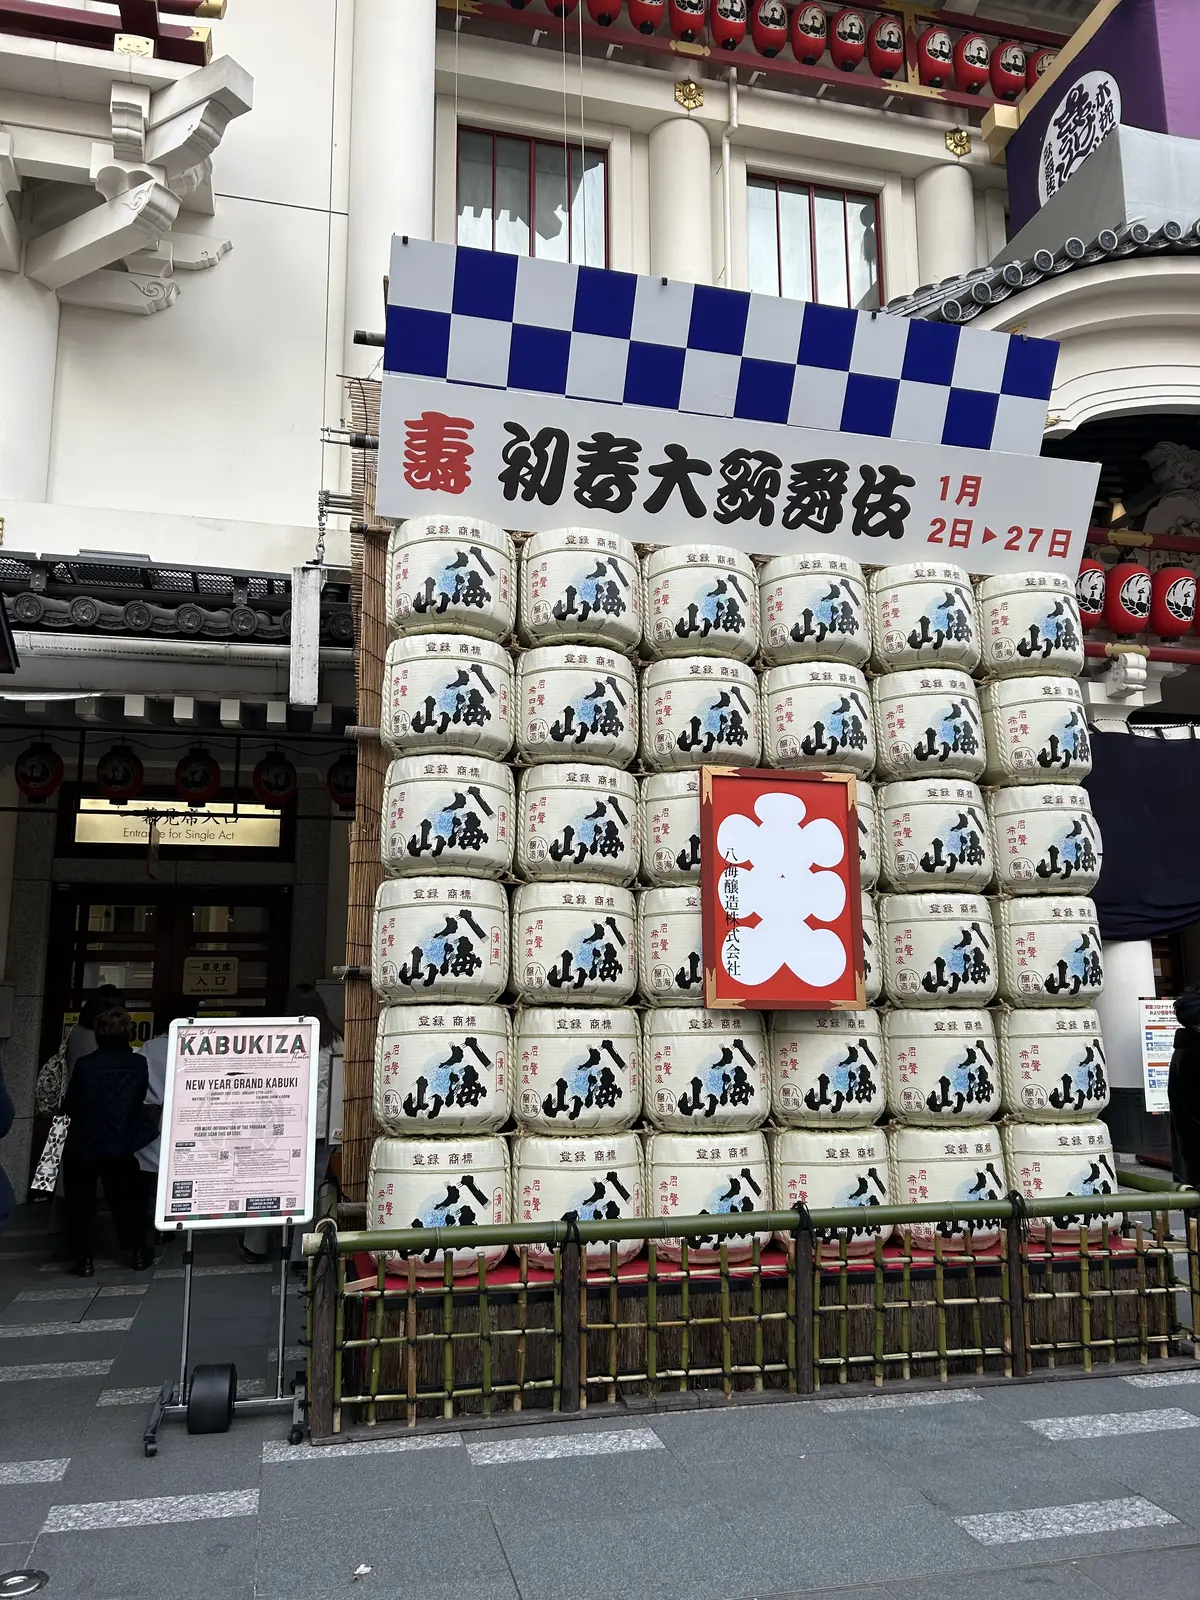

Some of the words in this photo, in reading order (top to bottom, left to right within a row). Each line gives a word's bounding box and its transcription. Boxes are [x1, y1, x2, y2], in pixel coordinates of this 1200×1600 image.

[498, 421, 916, 539] 初春大歌舞伎
[939, 475, 983, 508] 1月
[926, 517, 974, 549] 2日
[1004, 526, 1073, 559] 27日
[413, 546, 497, 614] 八海山
[553, 557, 631, 621] 八海山
[675, 574, 748, 638] 八海山
[790, 579, 861, 642] 八海山
[907, 587, 972, 650] 八海山
[1017, 597, 1079, 658] 八海山
[411, 664, 498, 734] 八海山
[550, 676, 627, 743] 八海山
[677, 686, 751, 752] 八海山
[801, 692, 867, 755] 八海山
[914, 698, 979, 762] 八海山
[1037, 706, 1089, 769] 八海山
[123, 828, 166, 838] Entrae
[169, 829, 182, 839] for
[185, 829, 215, 842] Single
[218, 830, 235, 840] Act
[407, 786, 496, 857] 八海山
[550, 796, 630, 864] 八海山
[920, 807, 985, 873] 八海山
[1036, 814, 1097, 879] 八海山
[724, 847, 741, 976] 八海醸造株式会社
[196, 975, 226, 986] 入口
[400, 910, 489, 987] 八海山
[547, 917, 626, 989] 八海山
[922, 922, 990, 994] 八海山
[1044, 927, 1103, 995] 八海山
[180, 1034, 307, 1056] KABUKIZA
[199, 1028, 207, 1036] to
[185, 1080, 206, 1091] NEW
[208, 1079, 232, 1090] YEAR
[233, 1078, 264, 1089] GRAND
[265, 1077, 299, 1088] KABUKI
[403, 1037, 494, 1119] 八海山
[542, 1040, 628, 1120] 八海山
[678, 1039, 758, 1117] 八海山
[804, 1039, 879, 1113] 八海山
[927, 1040, 994, 1114] 八海山
[1049, 1039, 1105, 1110] 八海山
